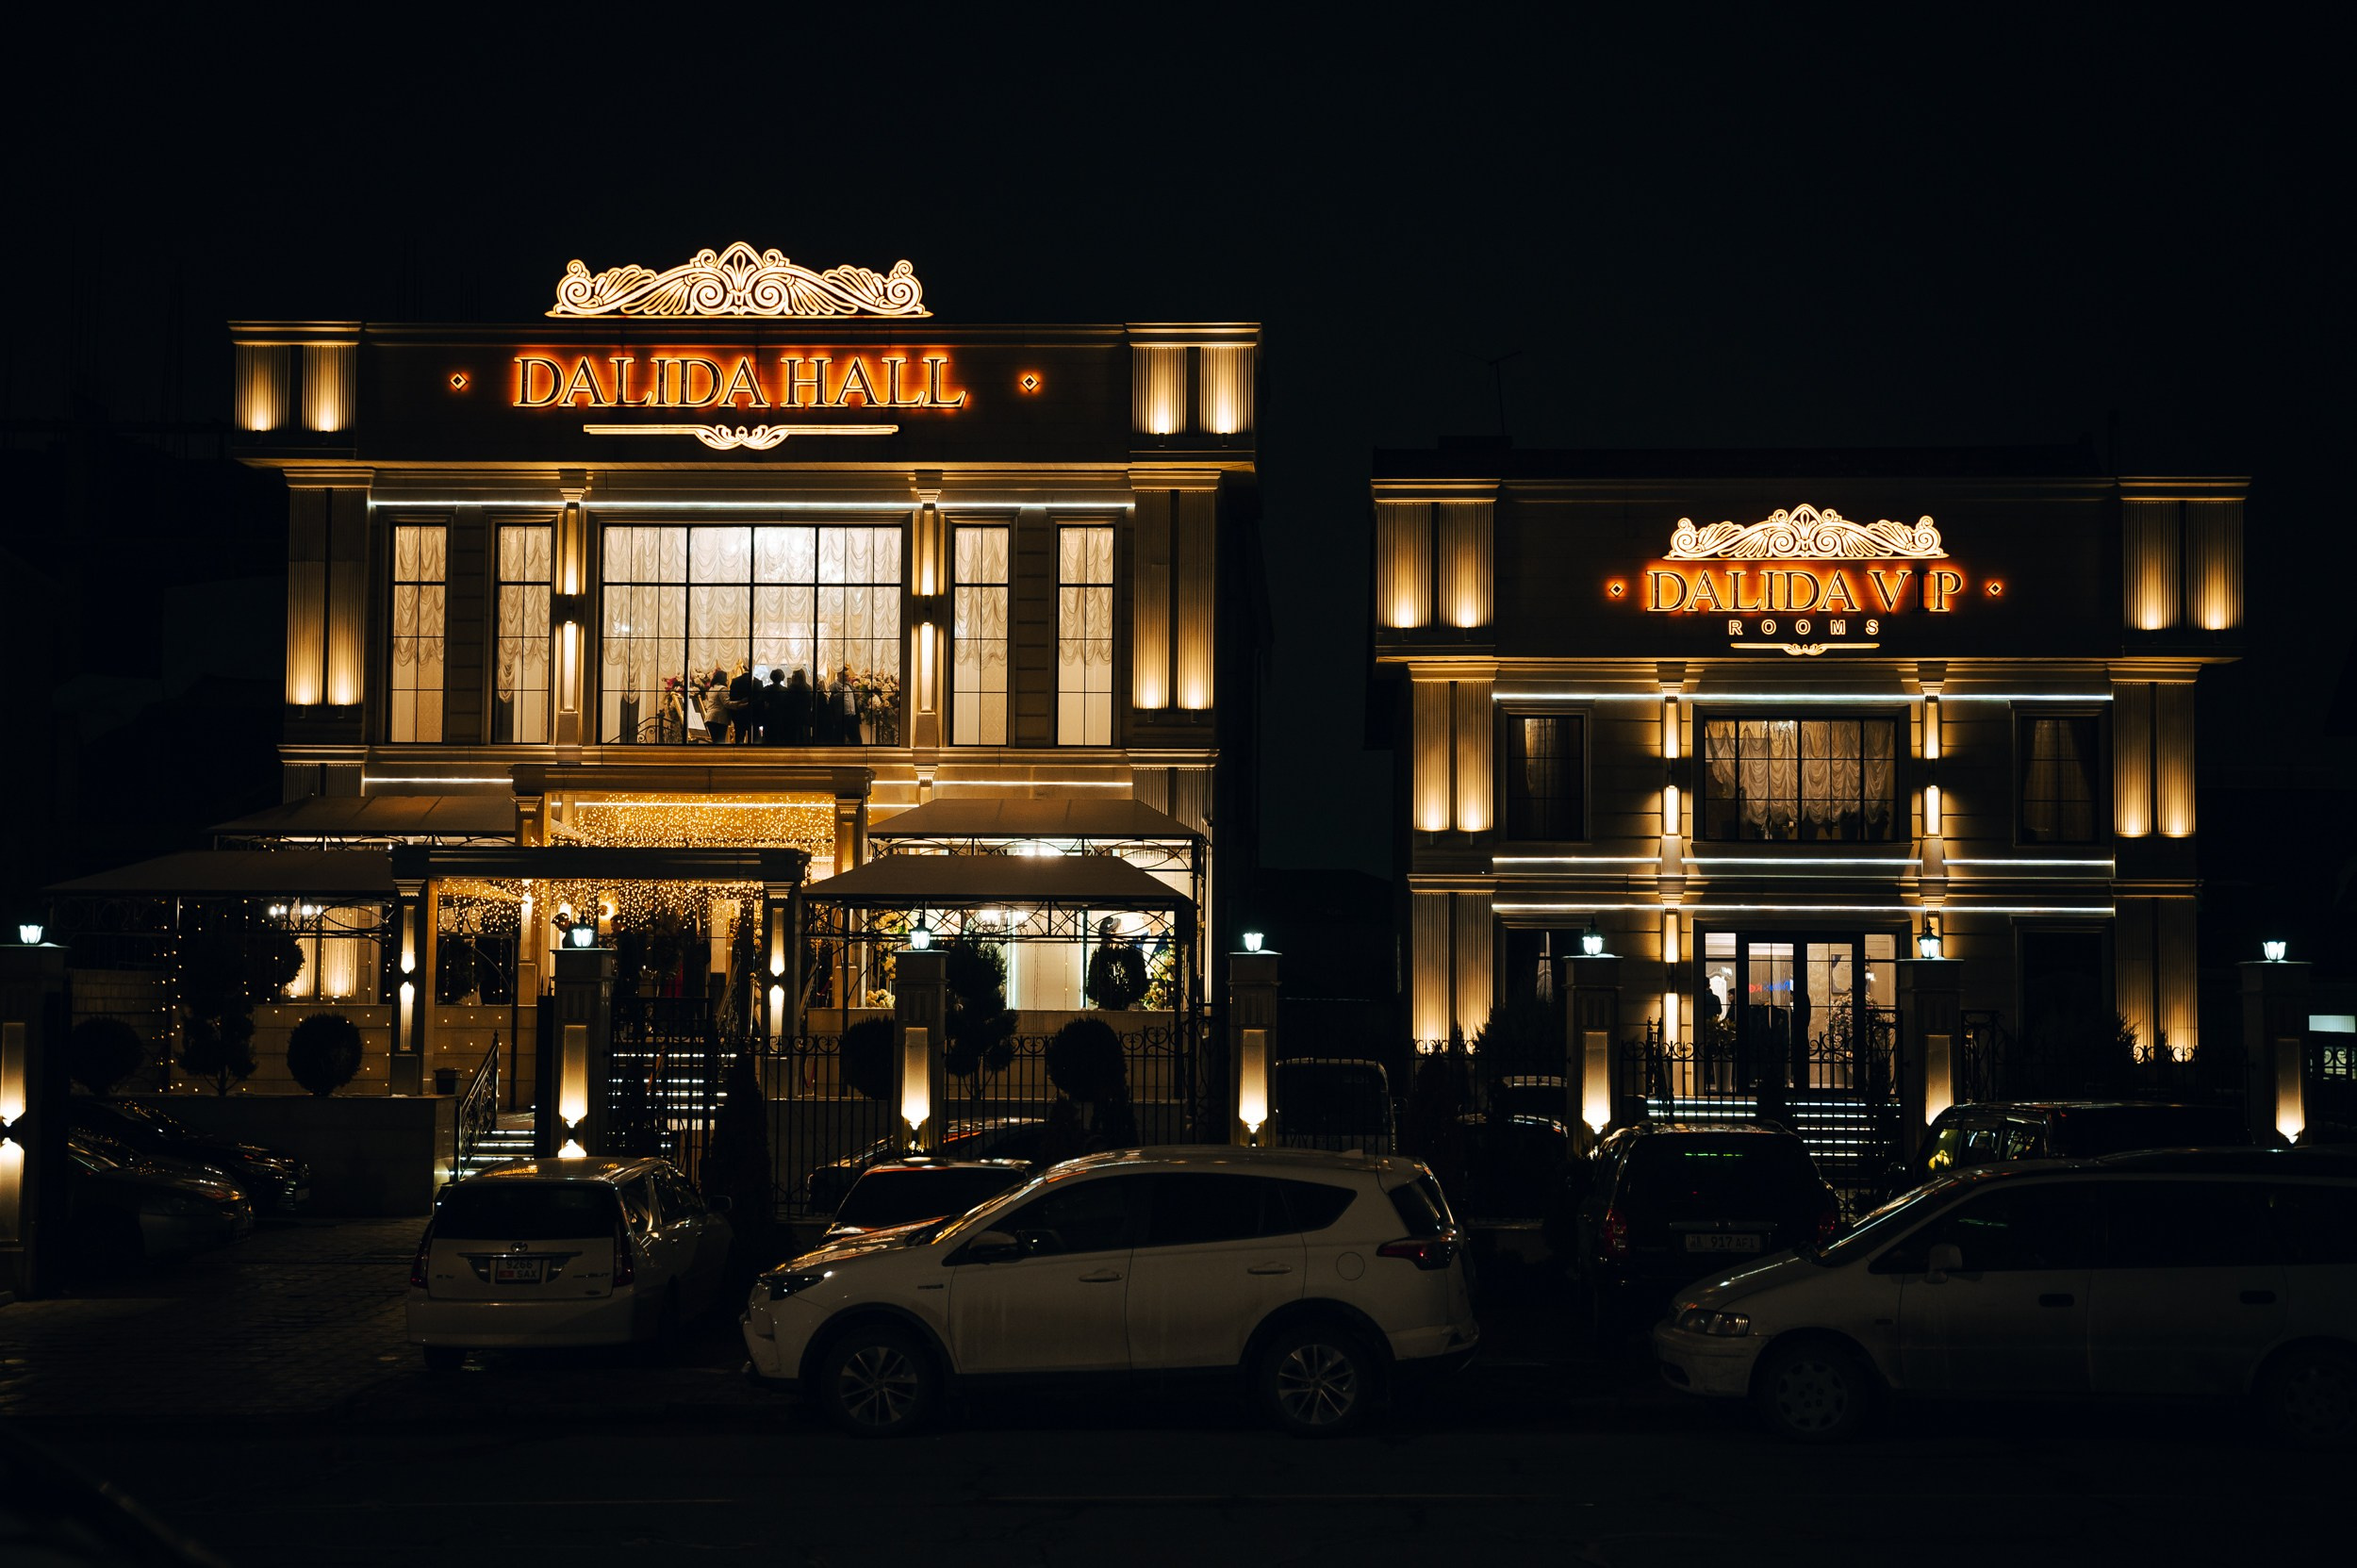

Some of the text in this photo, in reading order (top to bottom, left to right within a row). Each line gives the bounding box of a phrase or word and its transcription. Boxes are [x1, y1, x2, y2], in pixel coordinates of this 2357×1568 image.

[513, 355, 967, 408] DALIDA HALL
[1645, 569, 1964, 613] DALIDA VIP
[1728, 619, 1880, 636] ROOMS
